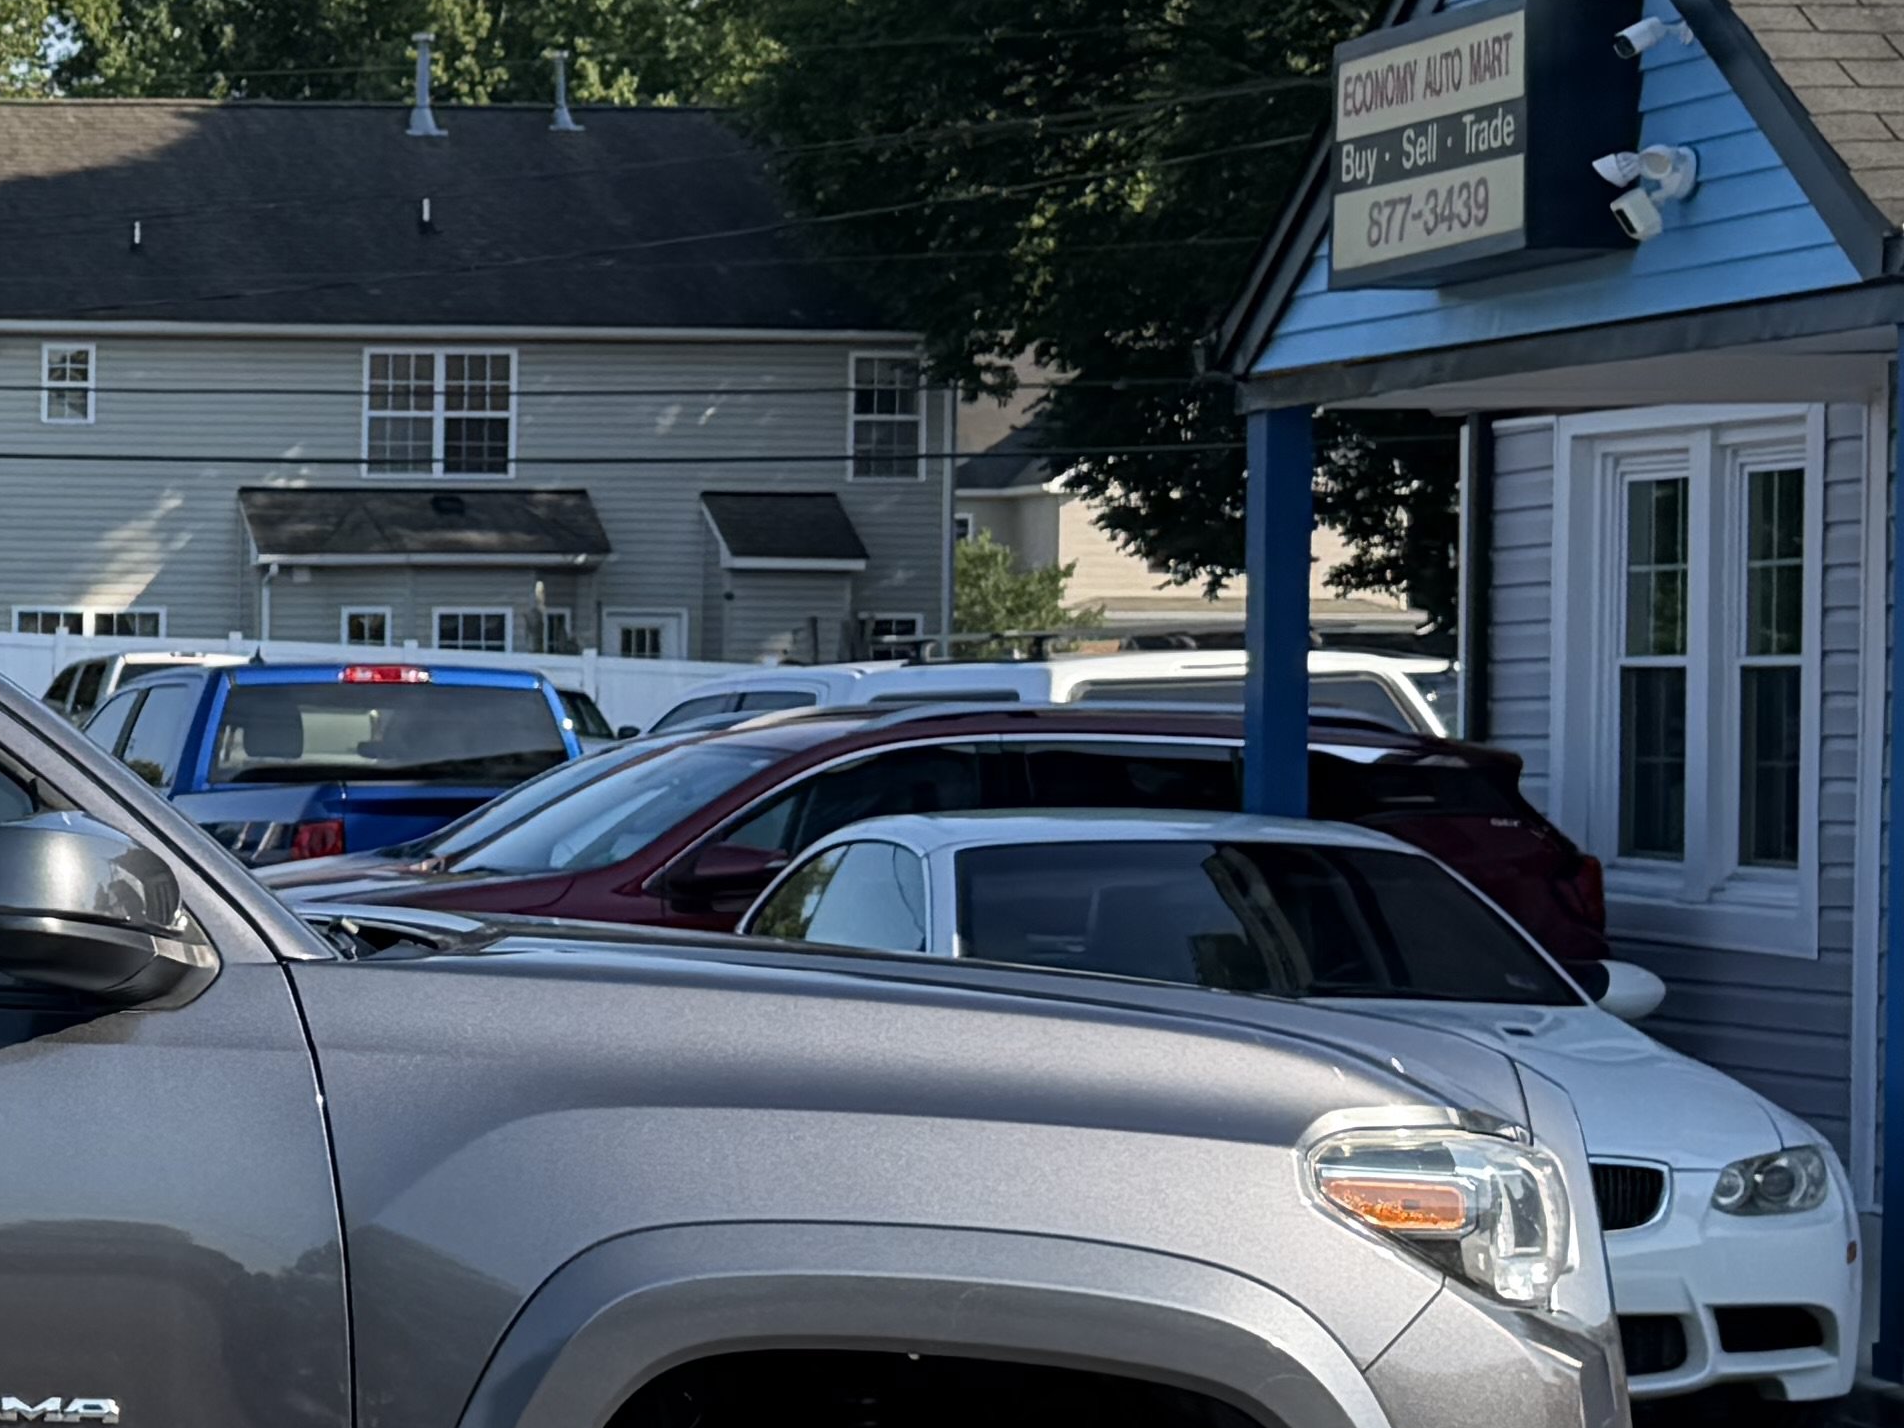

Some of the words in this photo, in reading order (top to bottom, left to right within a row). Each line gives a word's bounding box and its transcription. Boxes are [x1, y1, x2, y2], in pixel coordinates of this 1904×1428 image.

[1342, 60, 1418, 117] ECONOMY
[1422, 49, 1463, 101] AUTO
[1468, 32, 1514, 86] MART
[1341, 144, 1377, 185] Buy
[1401, 121, 1438, 170] Sell
[1461, 108, 1515, 155] Trade
[1367, 176, 1490, 249] 877-3439
